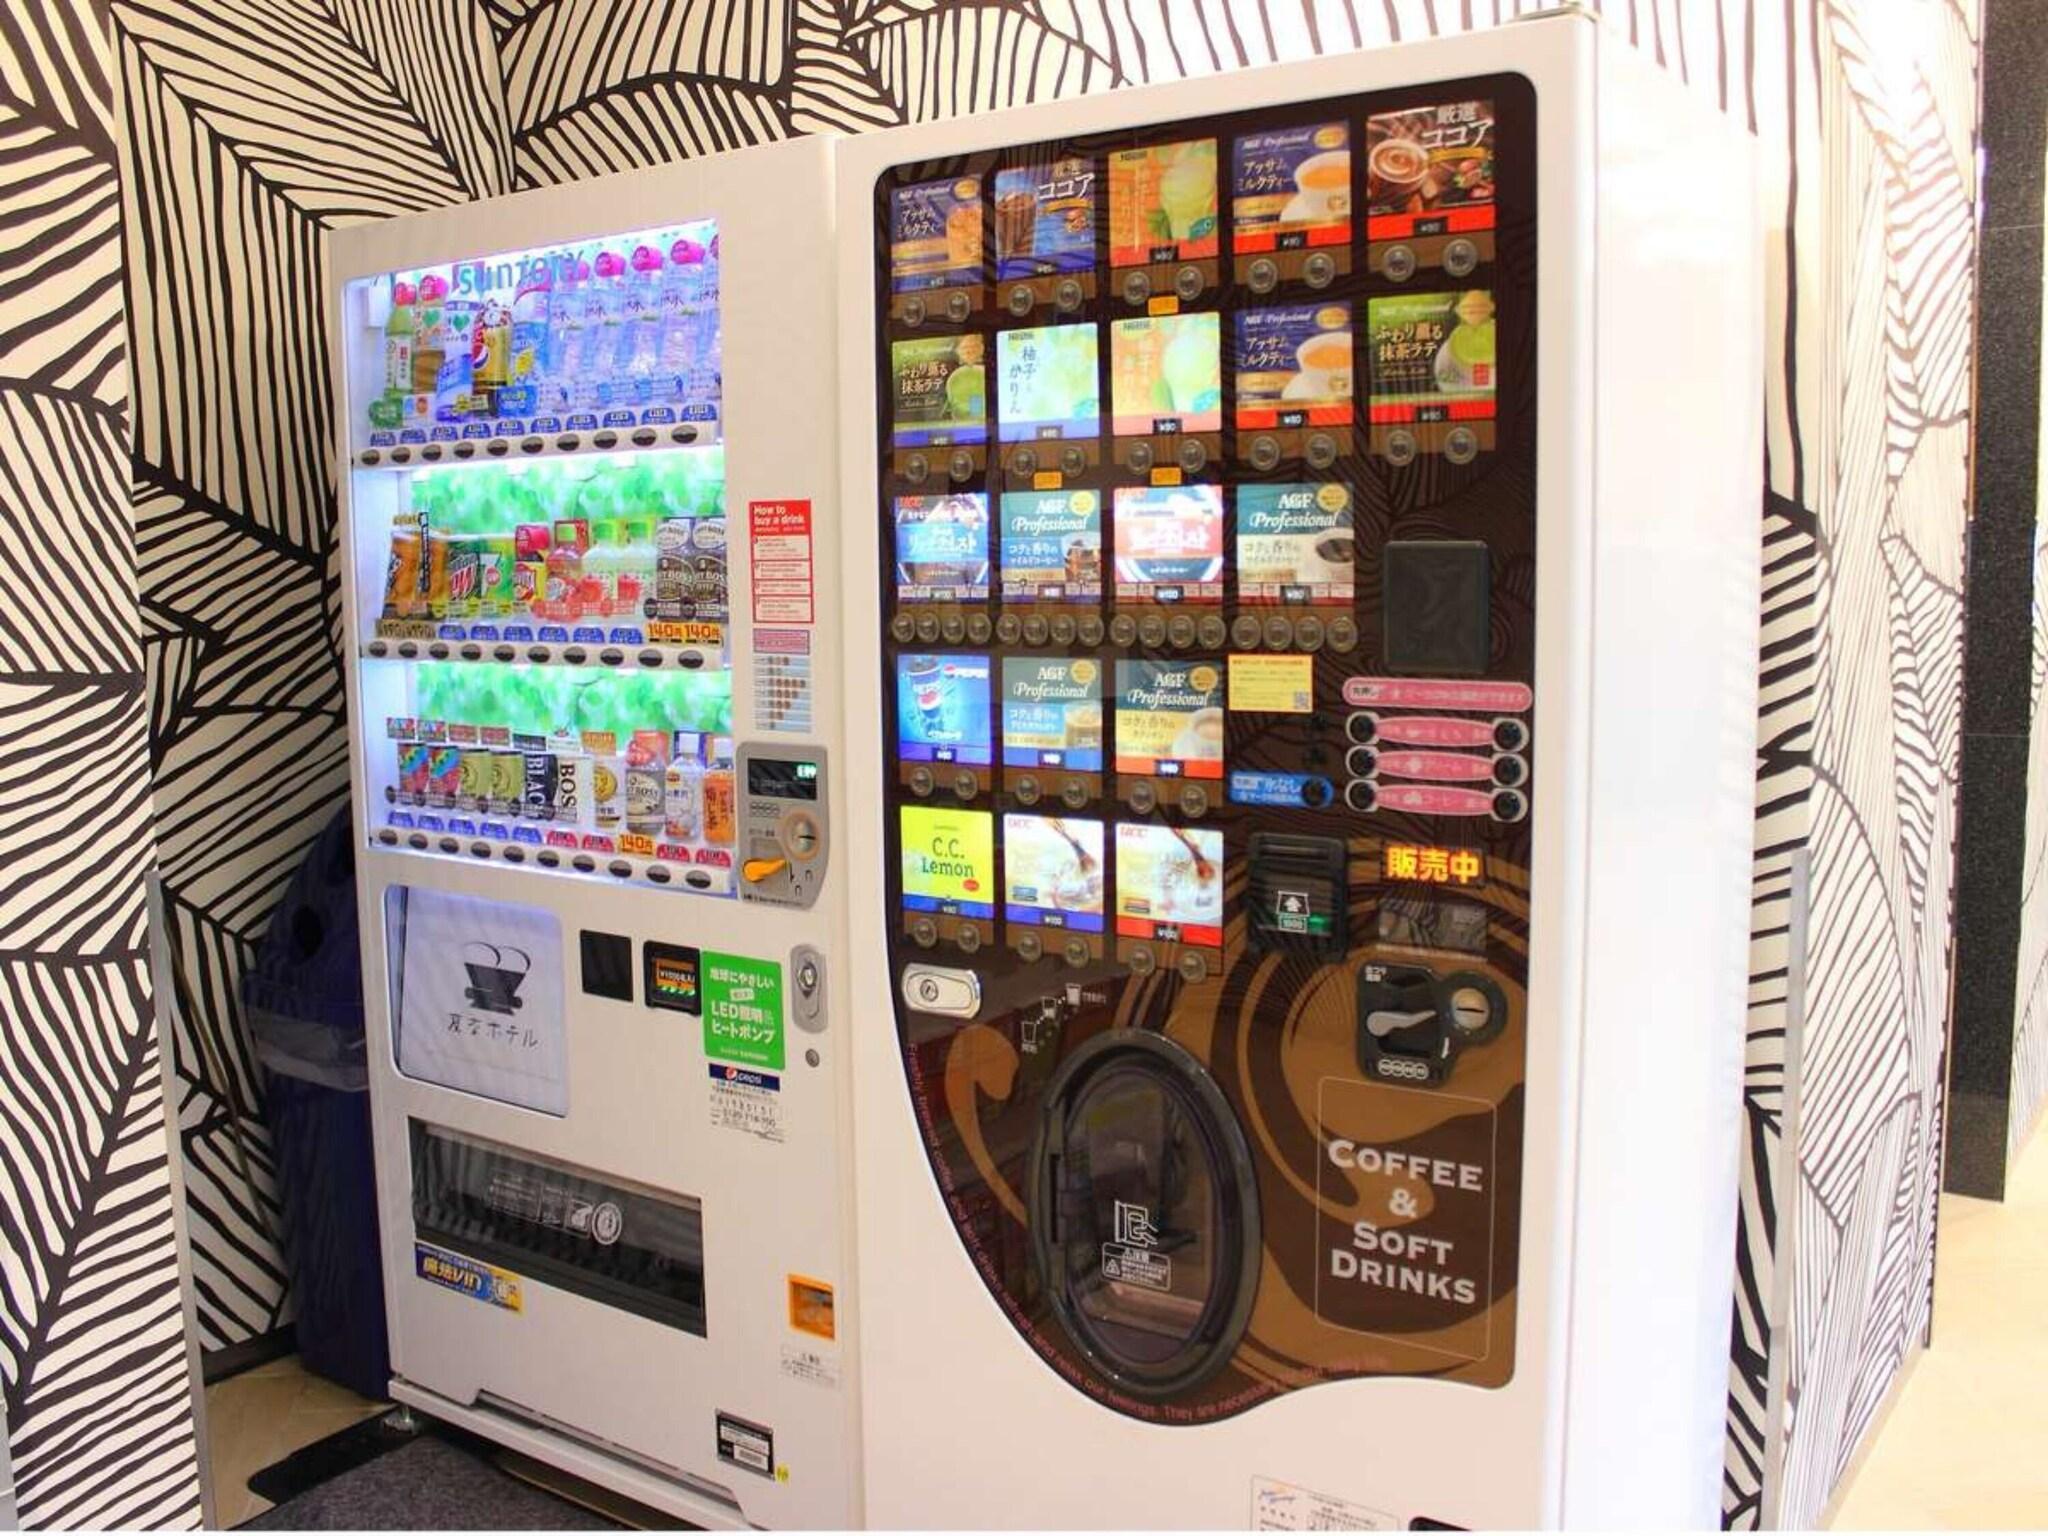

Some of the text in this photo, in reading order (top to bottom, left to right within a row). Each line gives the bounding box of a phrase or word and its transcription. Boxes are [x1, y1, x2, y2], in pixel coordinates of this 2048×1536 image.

[1421, 118, 1495, 149] ココア
[1037, 172, 1096, 200] ココア
[754, 505, 786, 516] How to
[1250, 511, 1339, 533] Professional
[1011, 515, 1088, 537] Professional
[1013, 681, 1089, 702] Professional
[1154, 672, 1187, 688] AGF
[1127, 687, 1212, 710] Professional
[525, 754, 548, 814] BLAC
[559, 763, 577, 808] BOS
[932, 836, 966, 860] C.C.
[921, 857, 975, 878] Lemon
[1387, 845, 1480, 884] 販売中
[709, 967, 776, 990] 地球にやさしい
[712, 1018, 776, 1045] ヒートポンプ
[1327, 1139, 1484, 1192] COFFEE
[1387, 1188, 1418, 1219] &
[1353, 1221, 1454, 1266] SOFT
[1331, 1248, 1477, 1305] DRINKS
